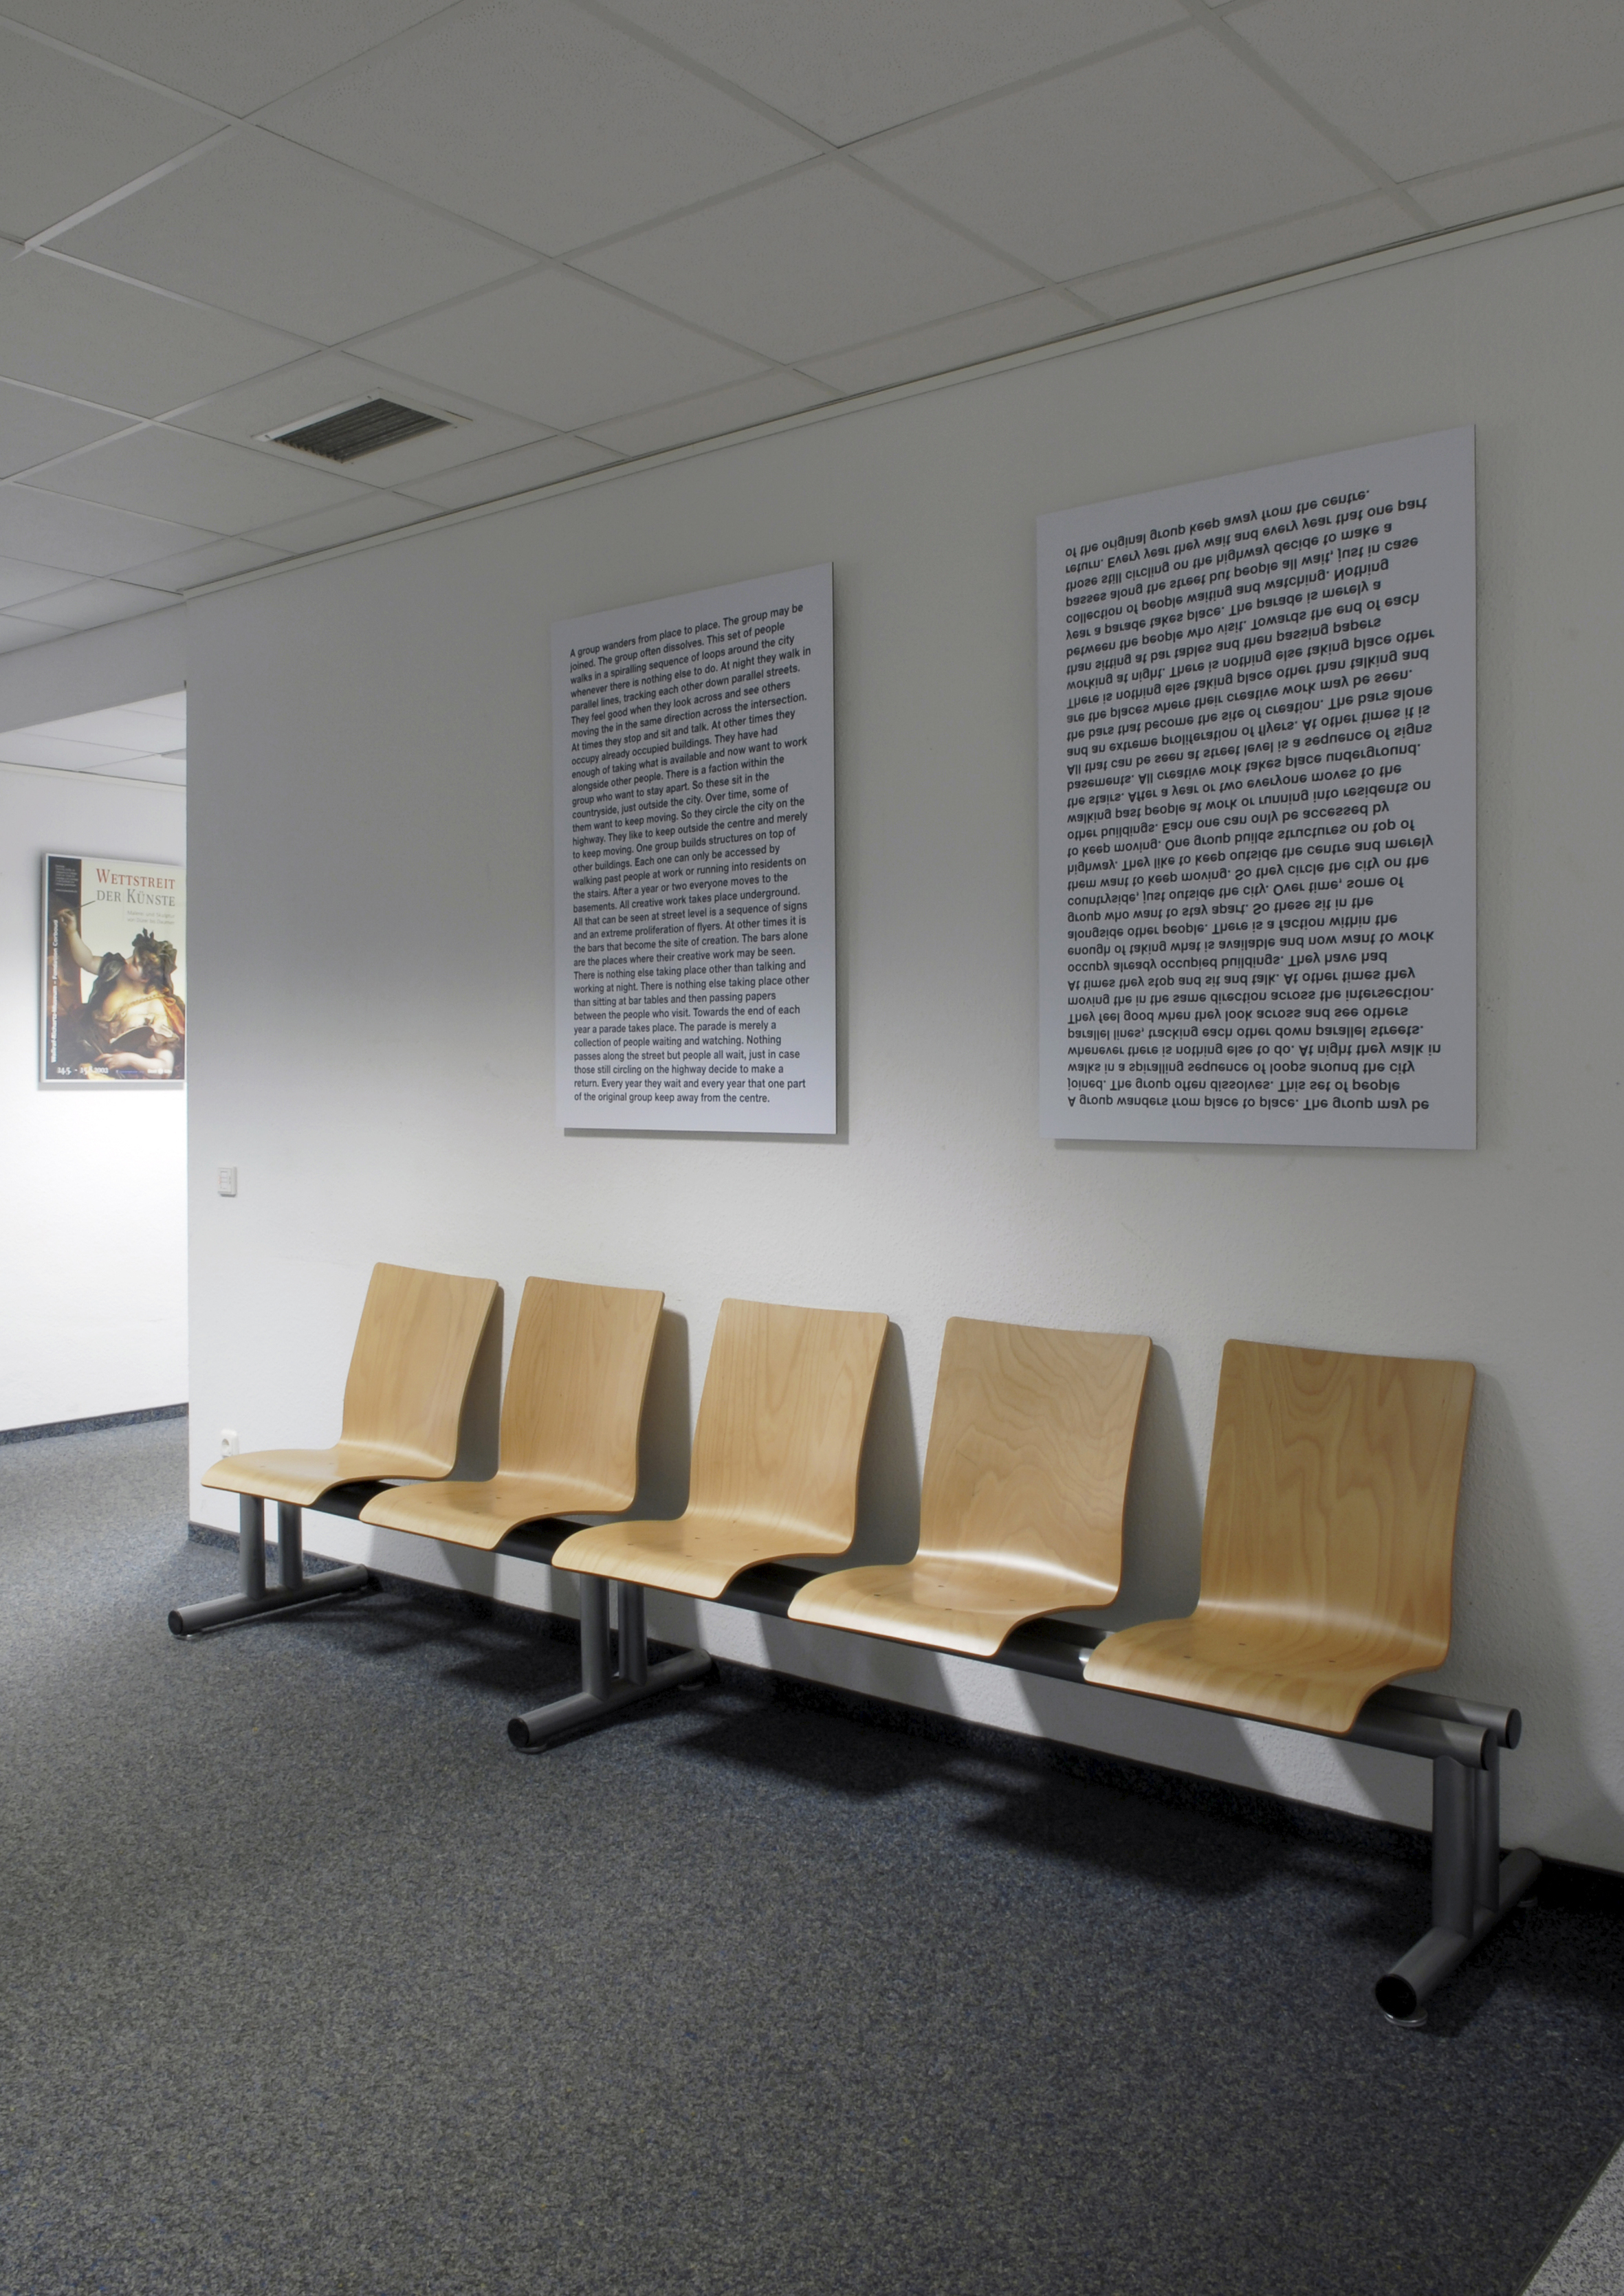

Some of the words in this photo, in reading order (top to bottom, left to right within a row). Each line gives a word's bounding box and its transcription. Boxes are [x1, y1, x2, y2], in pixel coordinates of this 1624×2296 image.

[569, 648, 575, 658] A
[577, 645, 600, 659] group
[602, 637, 636, 651] wanders
[637, 633, 657, 643] from
[659, 628, 681, 641] place
[683, 626, 692, 635] to
[694, 621, 721, 634] place.
[722, 616, 739, 627] The
[741, 611, 768, 626] group
[769, 606, 789, 618] may
[791, 603, 803, 613] be
[570, 698, 599, 714] parallel
[600, 696, 622, 706] lines,
[623, 689, 656, 702] tracking
[658, 684, 679, 696] each
[680, 681, 703, 692] other
[705, 676, 729, 688] down
[731, 668, 764, 685] parallel
[766, 663, 800, 677] streets.
[571, 779, 608, 792] alongside
[610, 776, 632, 787] other
[633, 771, 663, 786] people.
[665, 769, 689, 779] There
[691, 766, 699, 775] is
[707, 761, 738, 773] faction
[740, 756, 767, 769] within
[769, 755, 784, 764] the
[572, 863, 593, 872] other
[594, 859, 632, 870] buildings.
[634, 856, 655, 866] Each
[656, 856, 672, 864] one
[674, 854, 690, 863] can
[691, 850, 710, 861] only
[711, 849, 722, 859] be
[724, 843, 767, 858] accessed
[769, 843, 780, 854] by
[96, 868, 175, 890] WETTSTREIT
[96, 890, 122, 902] DER
[127, 888, 175, 907] KÜNSTE
[573, 944, 586, 953] the
[587, 943, 604, 952] bars
[606, 942, 622, 951] that
[624, 940, 656, 950] become
[657, 938, 671, 948] the
[673, 937, 689, 947] site
[690, 936, 699, 946] of
[701, 934, 739, 945] creation.
[741, 933, 758, 942] The
[760, 932, 780, 942] bars
[782, 930, 808, 940] alone
[573, 1011, 606, 1020] between
[608, 1010, 621, 1019] the
[622, 1008, 650, 1020] people
[651, 1008, 670, 1018] who
[671, 1008, 690, 1017] visit.
[692, 1006, 729, 1017] Towards
[730, 1006, 745, 1015] the
[747, 1005, 764, 1015] end
[766, 1004, 776, 1015] of
[778, 1004, 800, 1015] each
[573, 1092, 582, 1101] of
[583, 1092, 595, 1101] the
[597, 1092, 627, 1103] original
[628, 1094, 652, 1103] group
[654, 1092, 674, 1103] keep
[676, 1094, 699, 1104] away
[700, 1092, 721, 1102] from
[723, 1092, 737, 1102] the
[738, 1093, 769, 1103] centre.
